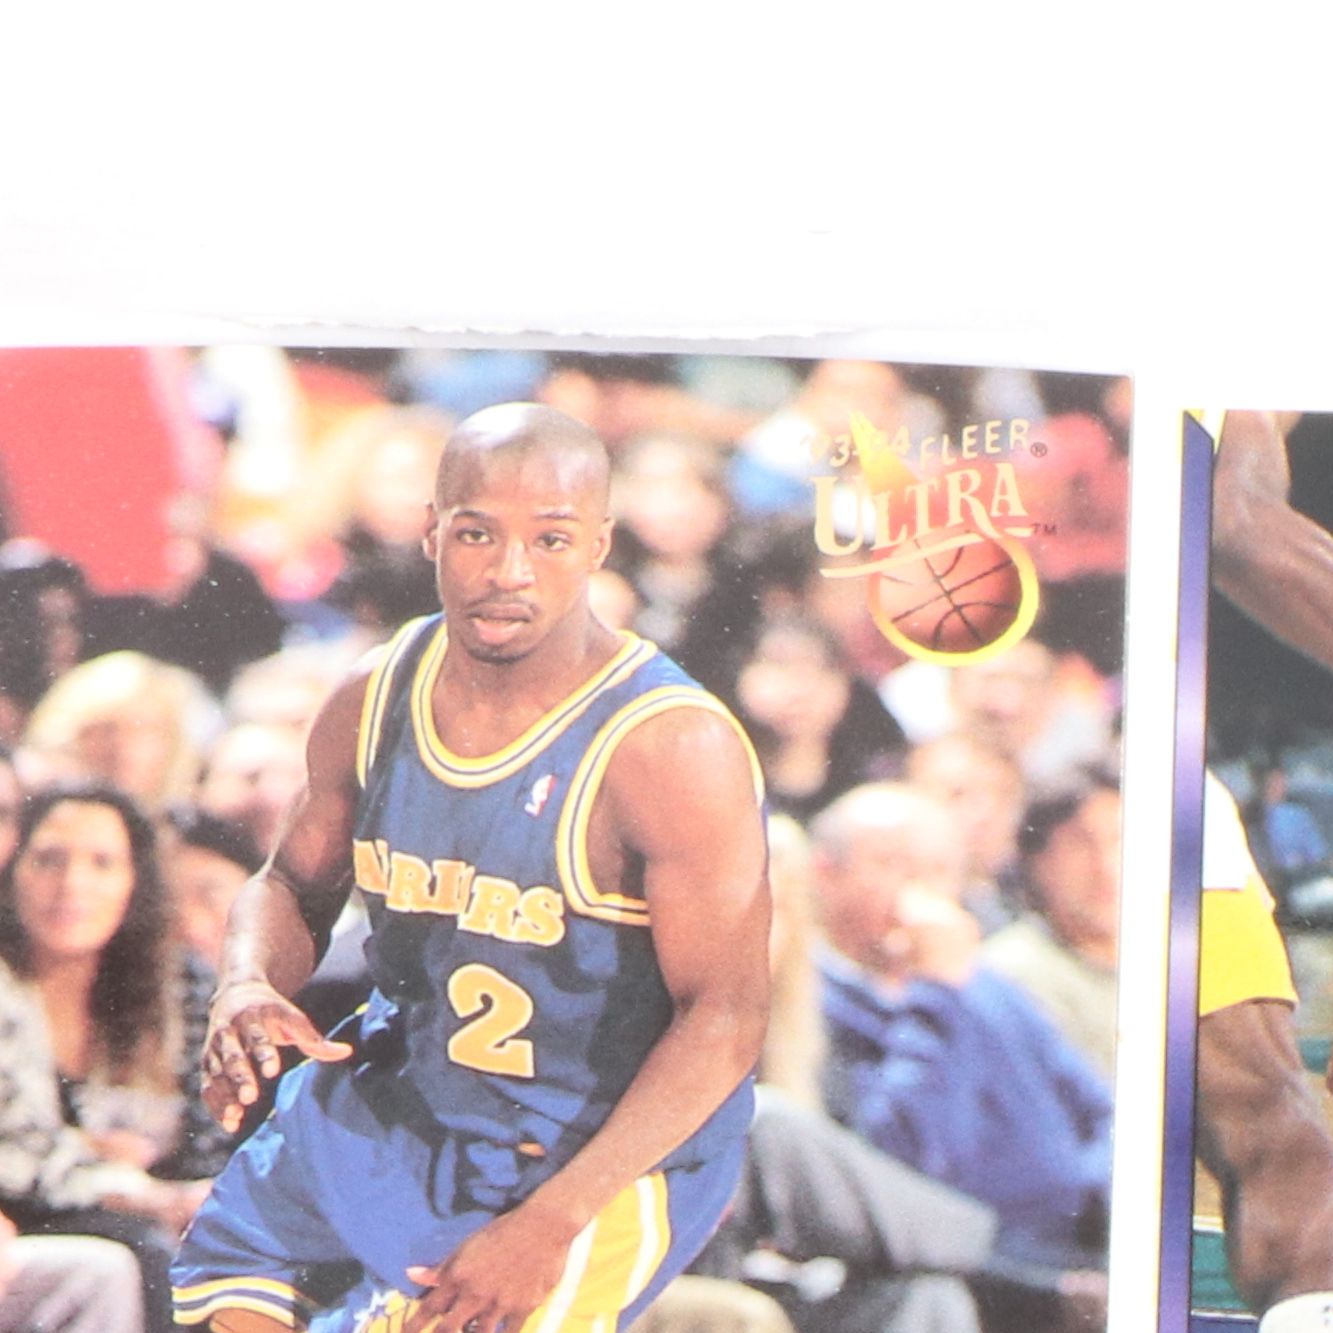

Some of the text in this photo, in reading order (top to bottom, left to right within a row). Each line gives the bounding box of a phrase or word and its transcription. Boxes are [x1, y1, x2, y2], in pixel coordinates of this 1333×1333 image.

[918, 418, 1030, 470] FLEER
[811, 462, 1029, 557] ULTRA
[447, 963, 535, 1078] 2
